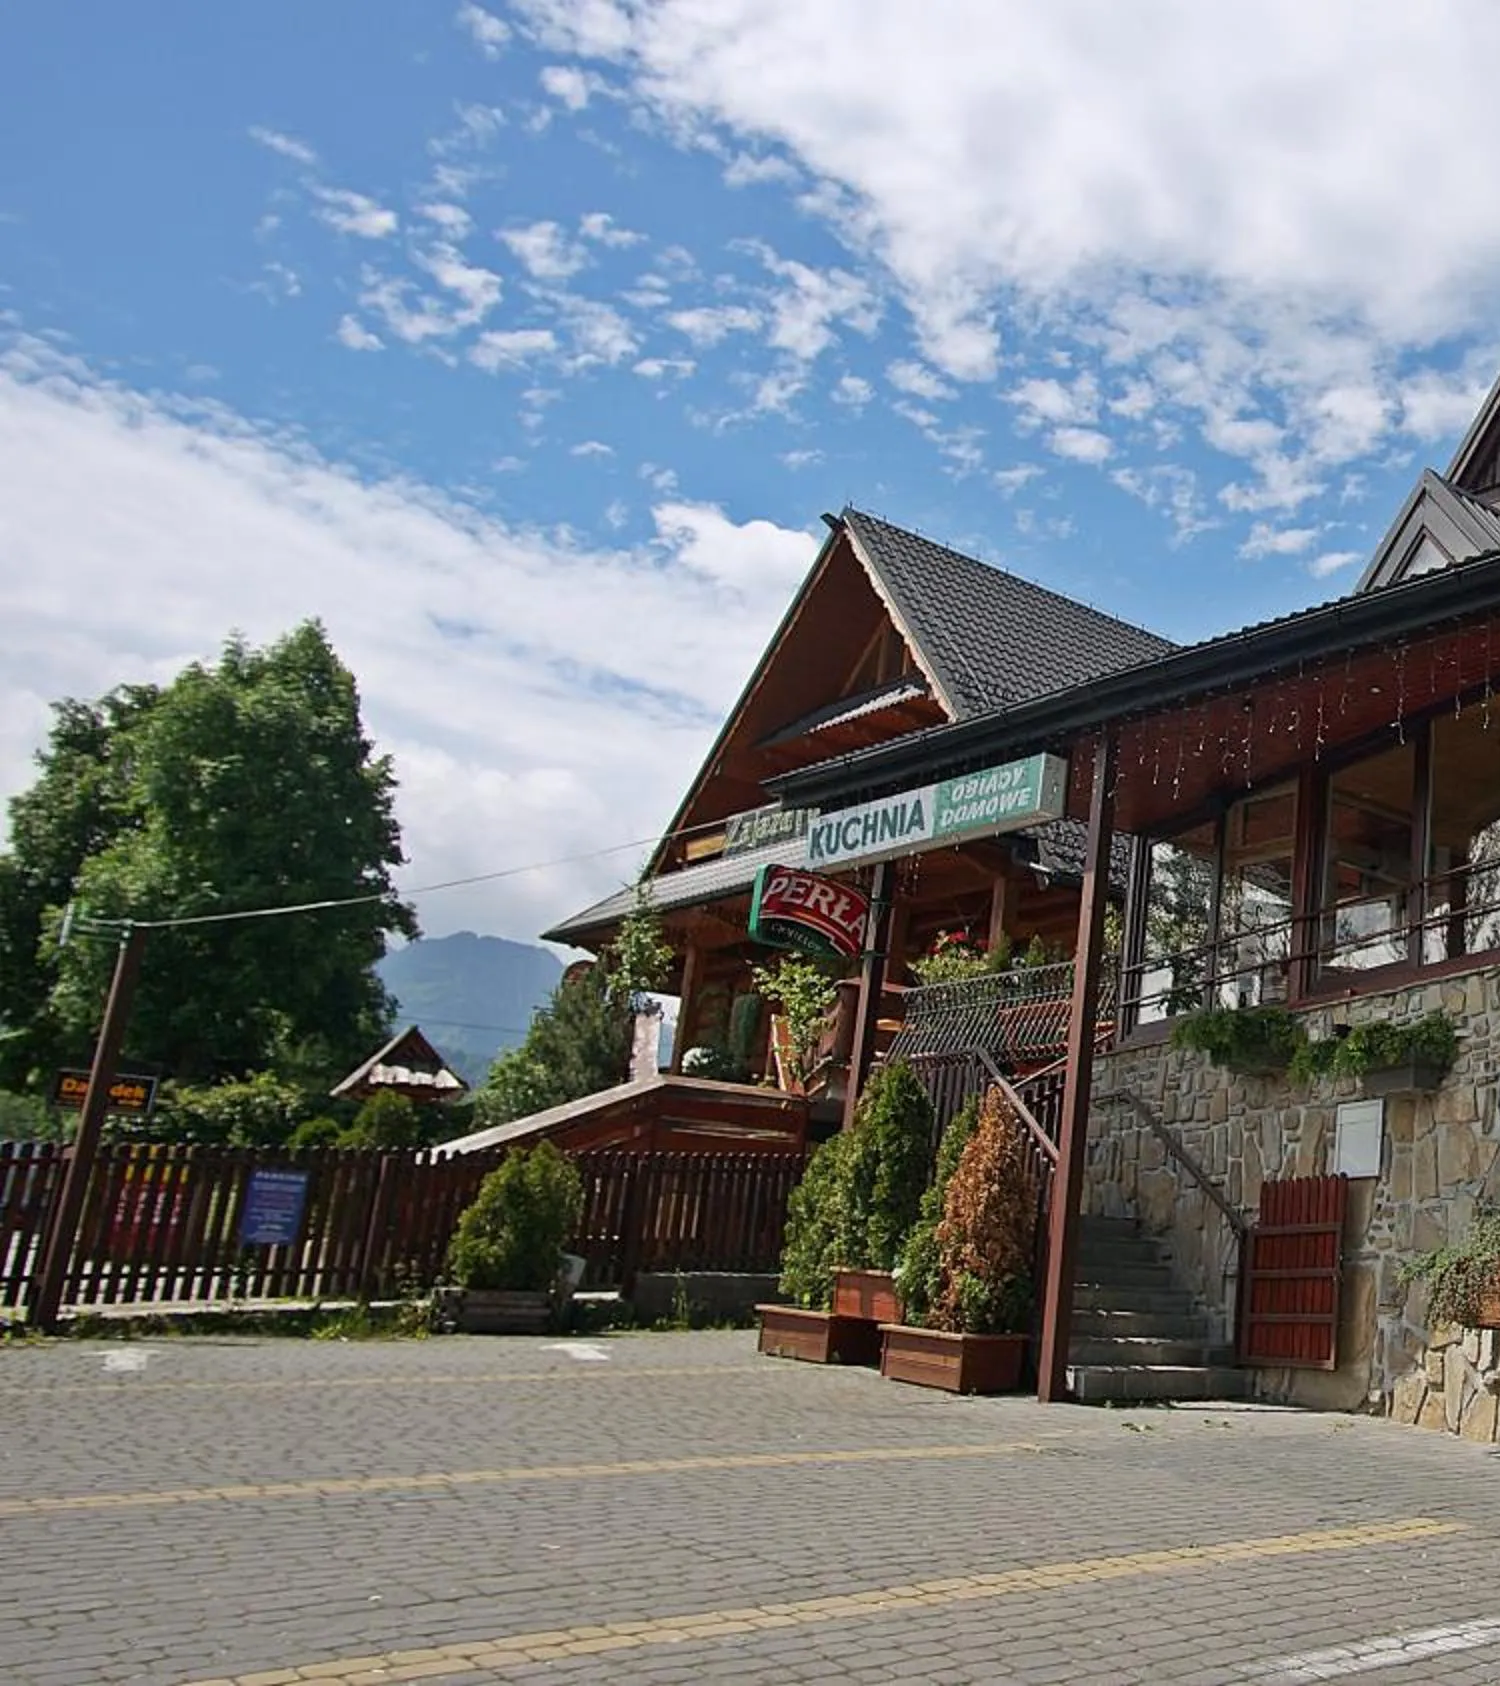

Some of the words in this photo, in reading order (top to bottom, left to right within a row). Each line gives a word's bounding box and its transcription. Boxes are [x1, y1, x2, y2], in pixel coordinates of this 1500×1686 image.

[940, 788, 1032, 828] DOMOWE
[951, 766, 1027, 802] OBIADY
[809, 799, 925, 860] KUCHNIA
[760, 875, 867, 945] PERŁA
